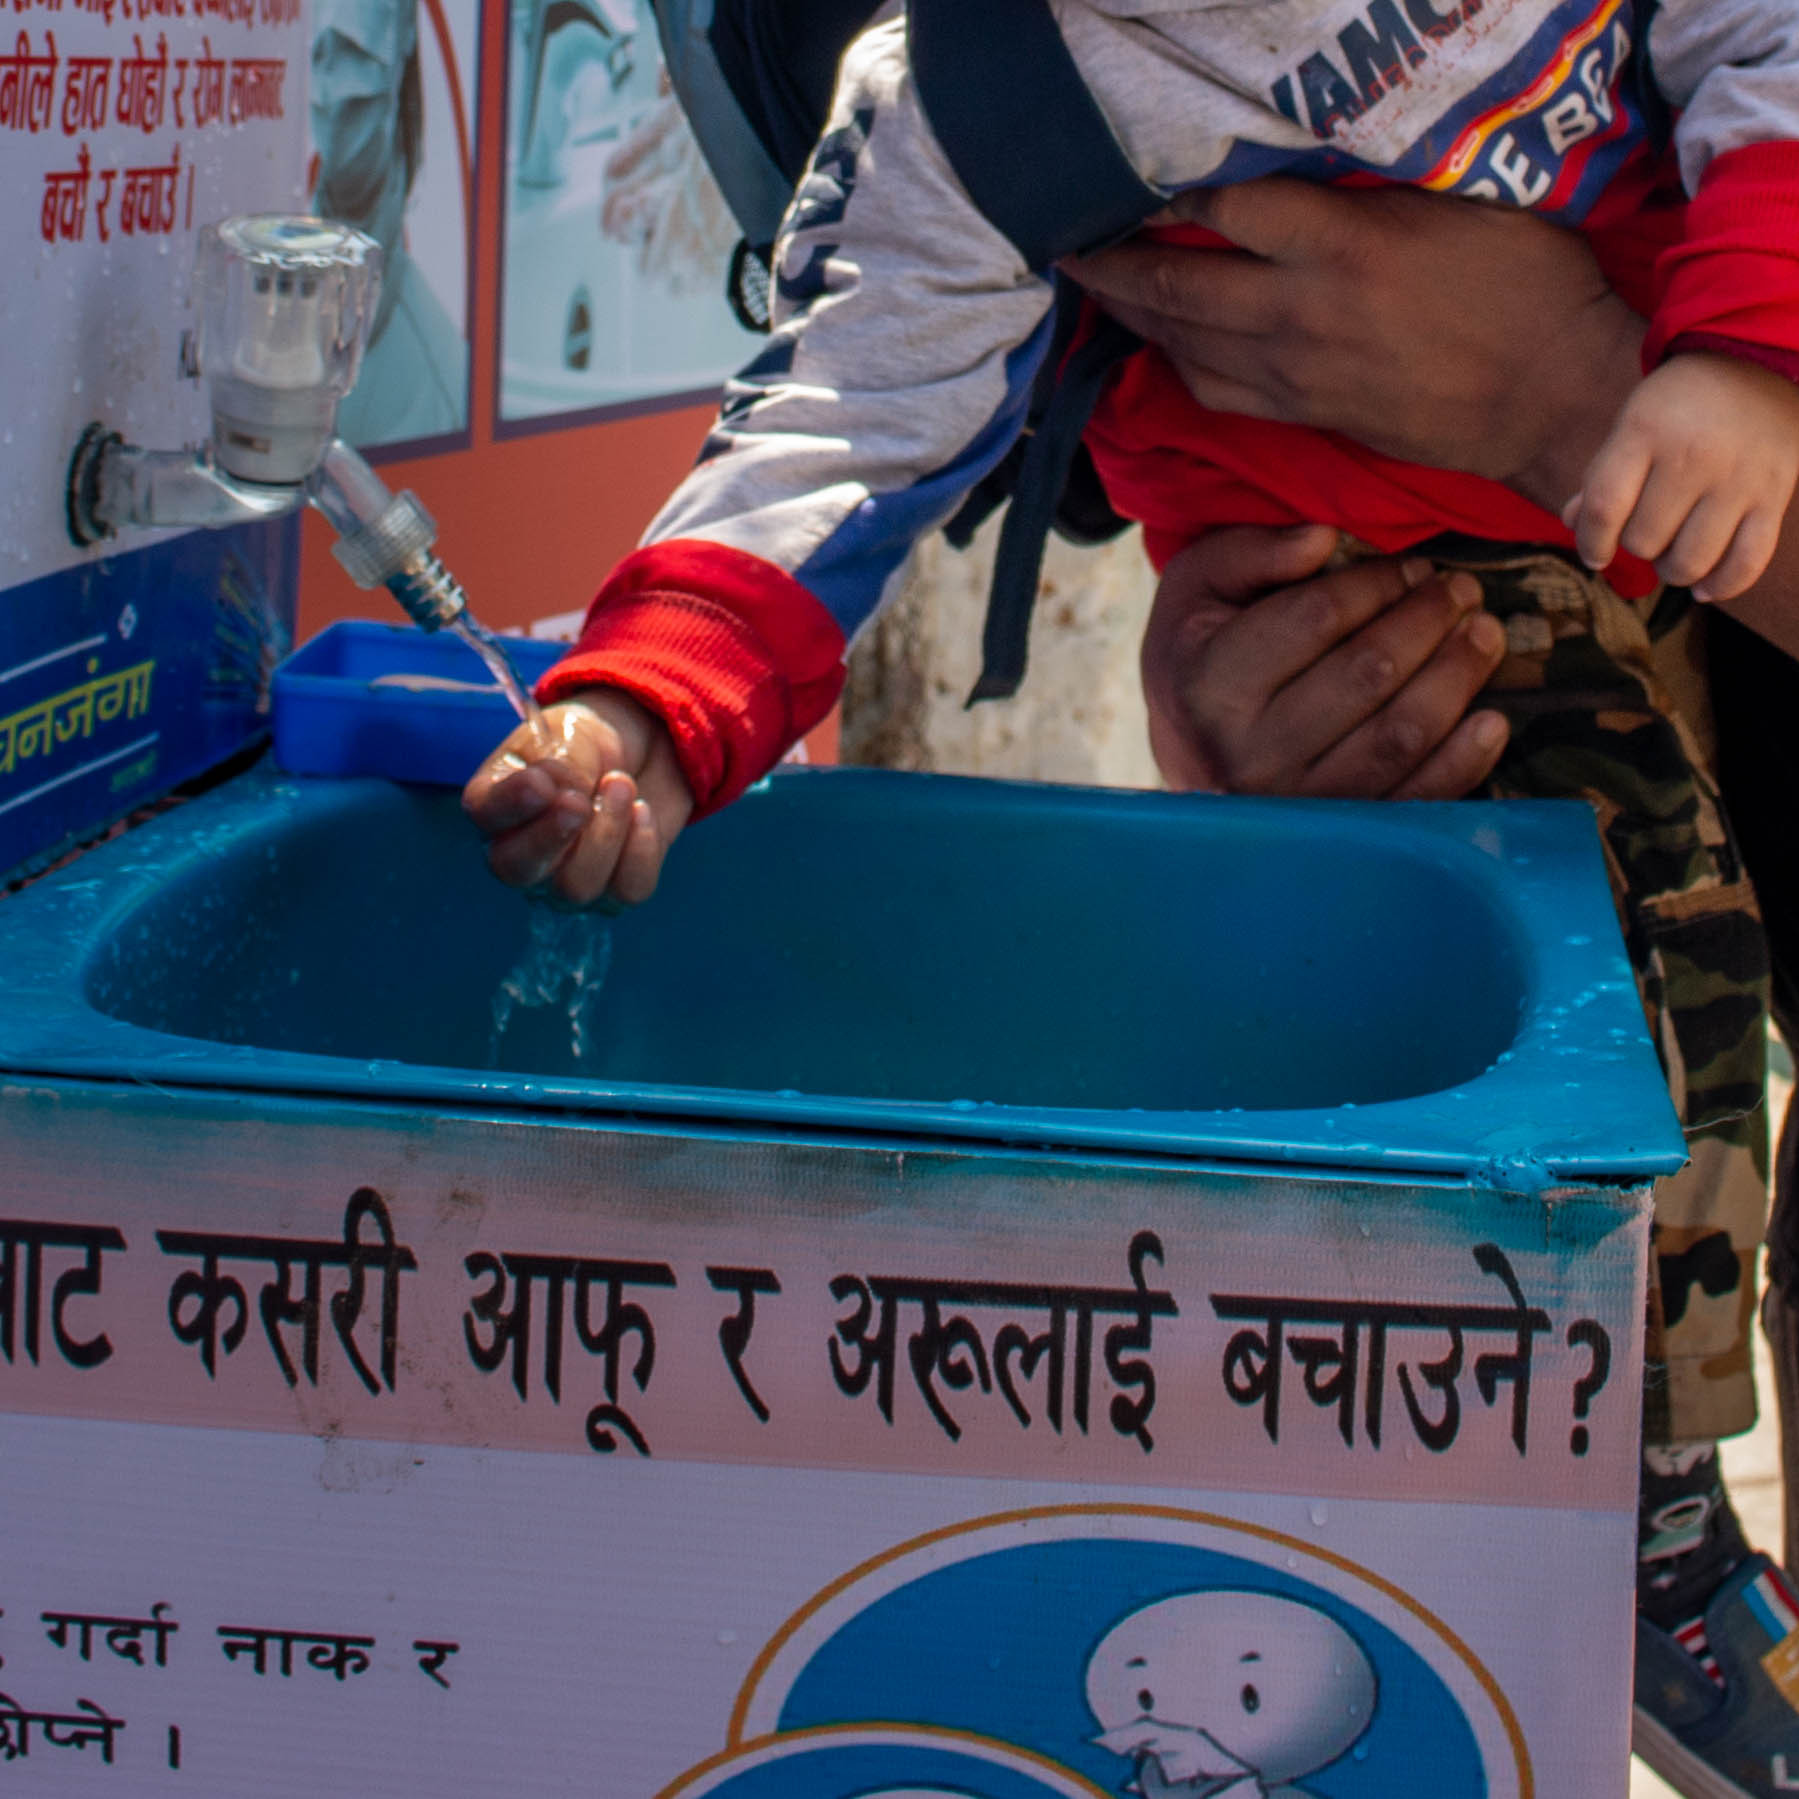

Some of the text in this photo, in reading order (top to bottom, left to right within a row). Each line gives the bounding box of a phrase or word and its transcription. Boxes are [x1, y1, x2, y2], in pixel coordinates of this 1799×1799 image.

[60, 55, 114, 137] हात
[172, 58, 189, 130] र
[95, 168, 118, 243] र
[154, 1186, 418, 1397] कसरी
[462, 1251, 677, 1457] आफू
[705, 1265, 781, 1424] र
[827, 1229, 1180, 1453] अरूलाई
[40, 1601, 179, 1667] गर्दा
[216, 1625, 376, 1682] नाक
[412, 1639, 460, 1689] र
